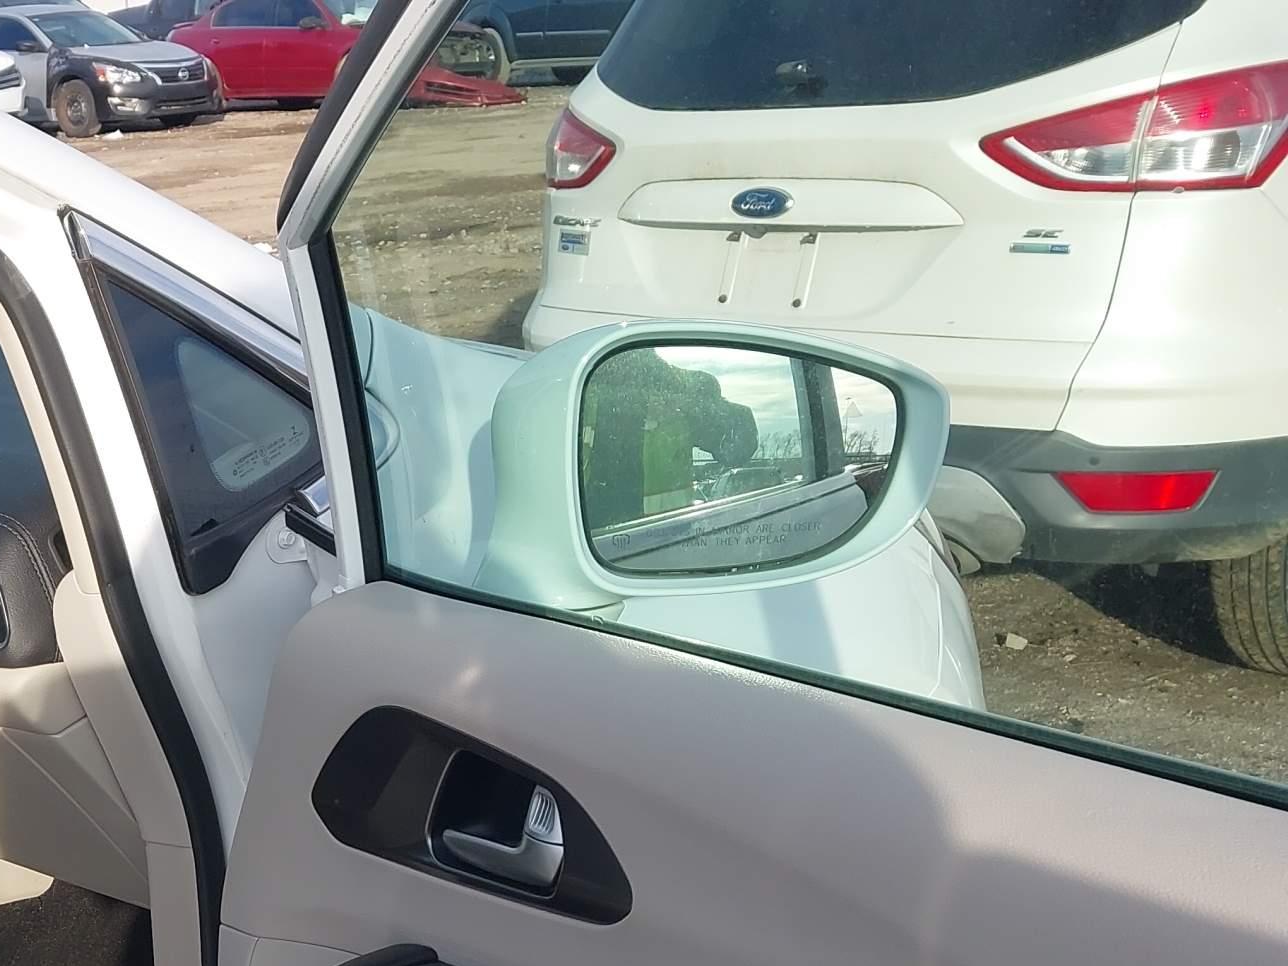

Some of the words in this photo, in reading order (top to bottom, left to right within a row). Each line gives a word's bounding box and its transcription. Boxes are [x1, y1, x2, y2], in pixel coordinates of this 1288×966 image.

[741, 193, 776, 210] Ford
[1023, 229, 1064, 239] SE
[756, 522, 775, 534] ARE
[781, 519, 821, 533] CLOSER
[715, 535, 739, 546] THEY
[745, 534, 785, 545] APPEAR
